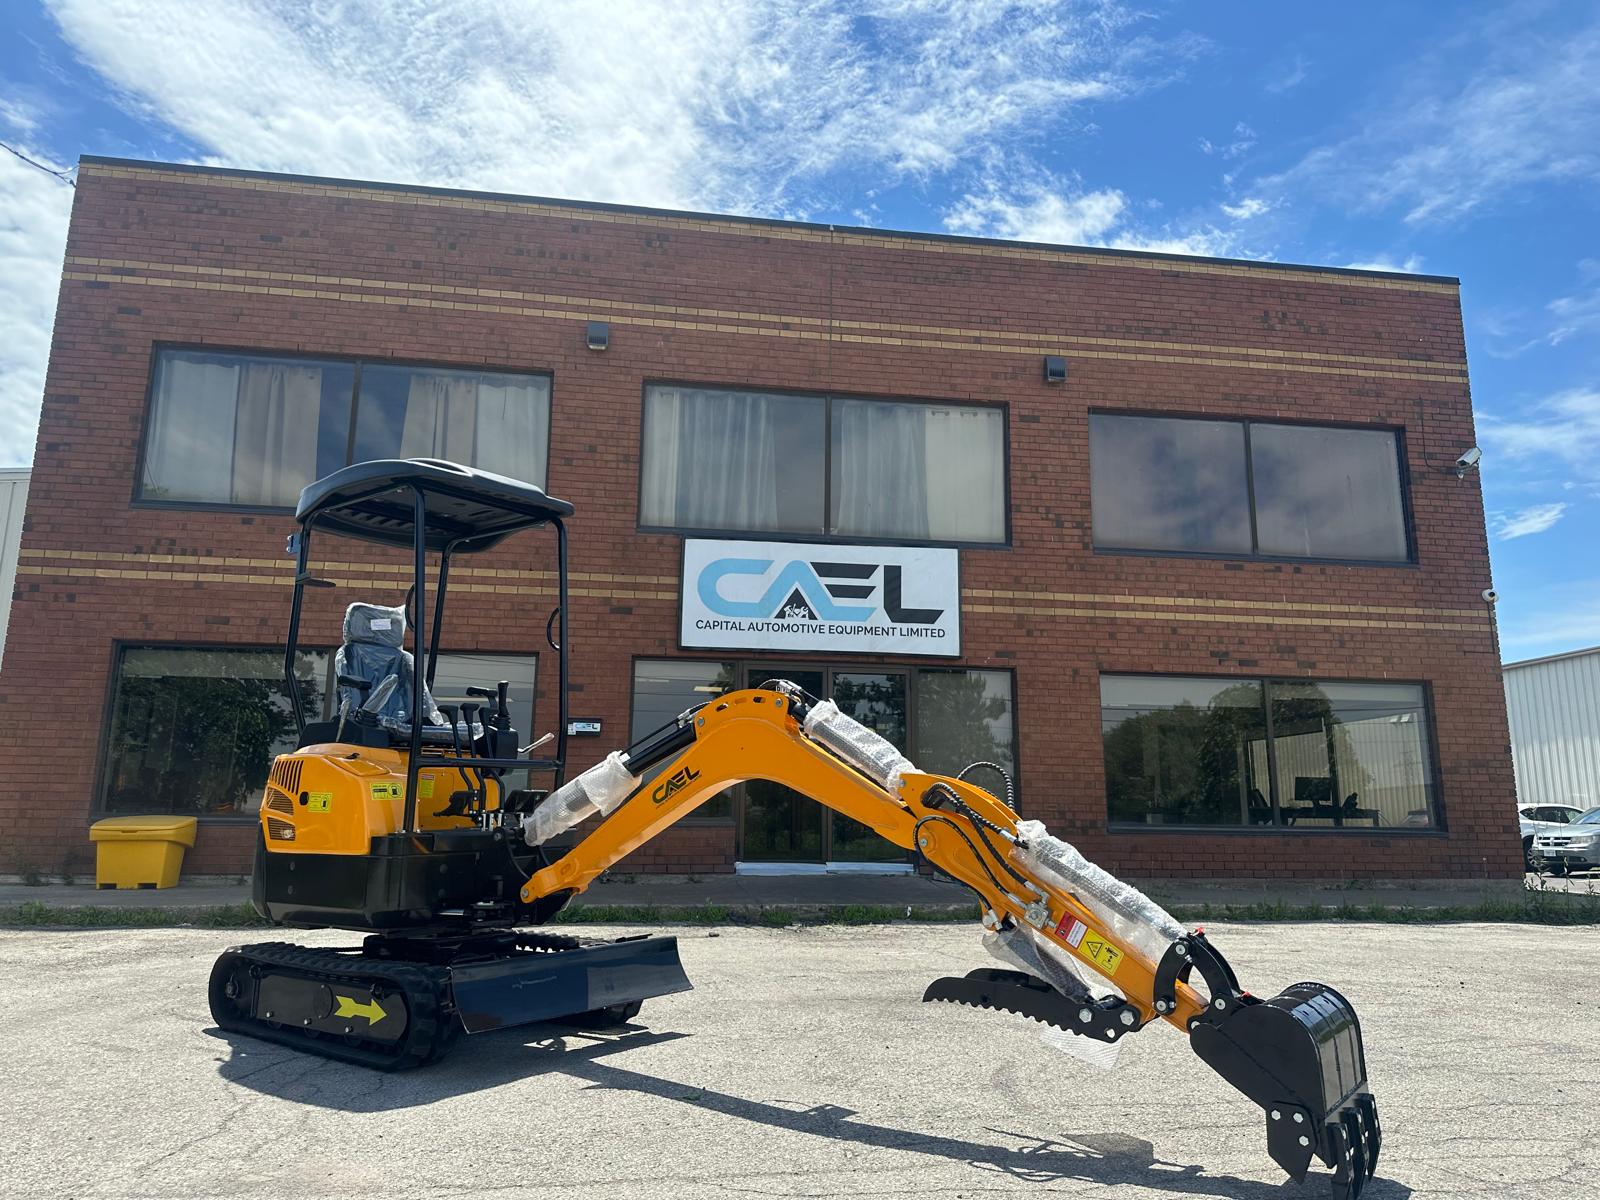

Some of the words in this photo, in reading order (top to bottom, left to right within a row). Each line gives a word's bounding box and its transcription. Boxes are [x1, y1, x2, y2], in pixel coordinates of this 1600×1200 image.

[697, 558, 944, 623] CAEL
[695, 619, 746, 632] CAPITAL
[747, 621, 826, 634] AUTOMOTIVE
[828, 624, 897, 637] EQUIPMENT
[899, 627, 945, 639] LIMITED
[652, 766, 701, 804] CAEL
